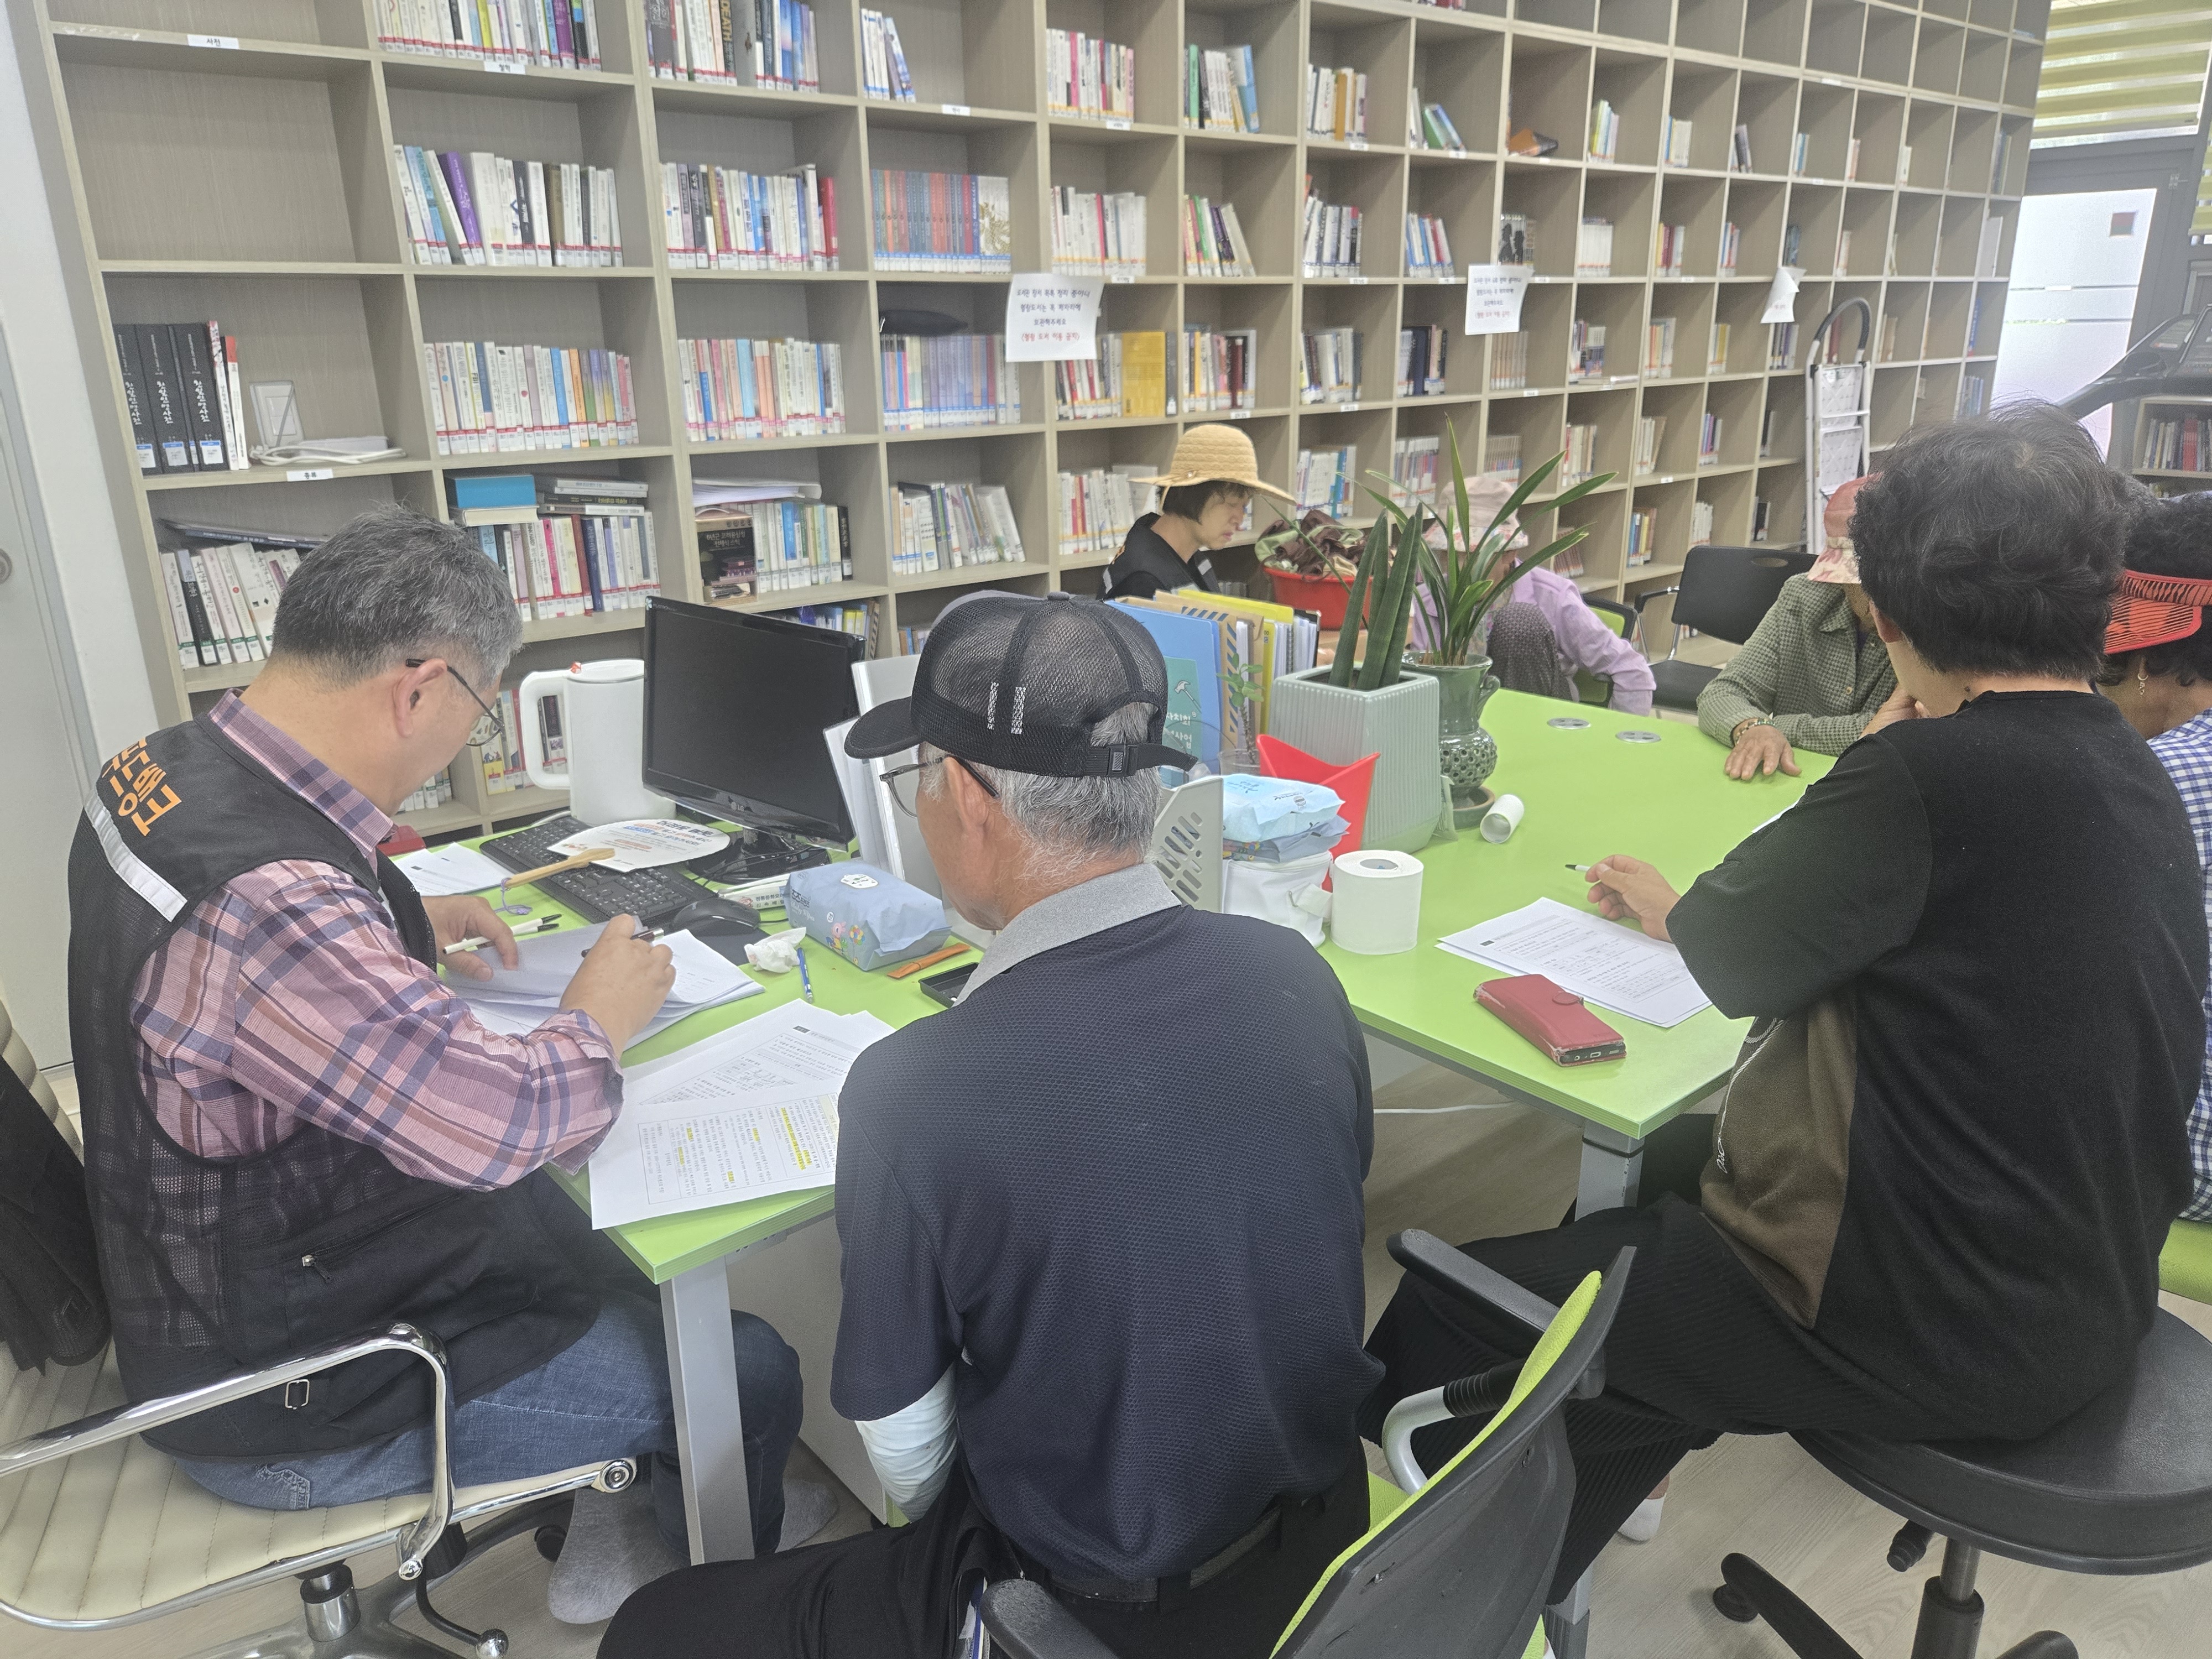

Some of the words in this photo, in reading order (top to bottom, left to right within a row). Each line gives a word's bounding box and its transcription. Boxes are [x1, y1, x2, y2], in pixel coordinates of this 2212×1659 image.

[126, 382, 142, 425] 친일인명사전
[157, 380, 173, 424] 친일인명사전
[194, 380, 210, 422] 친일인명사전
